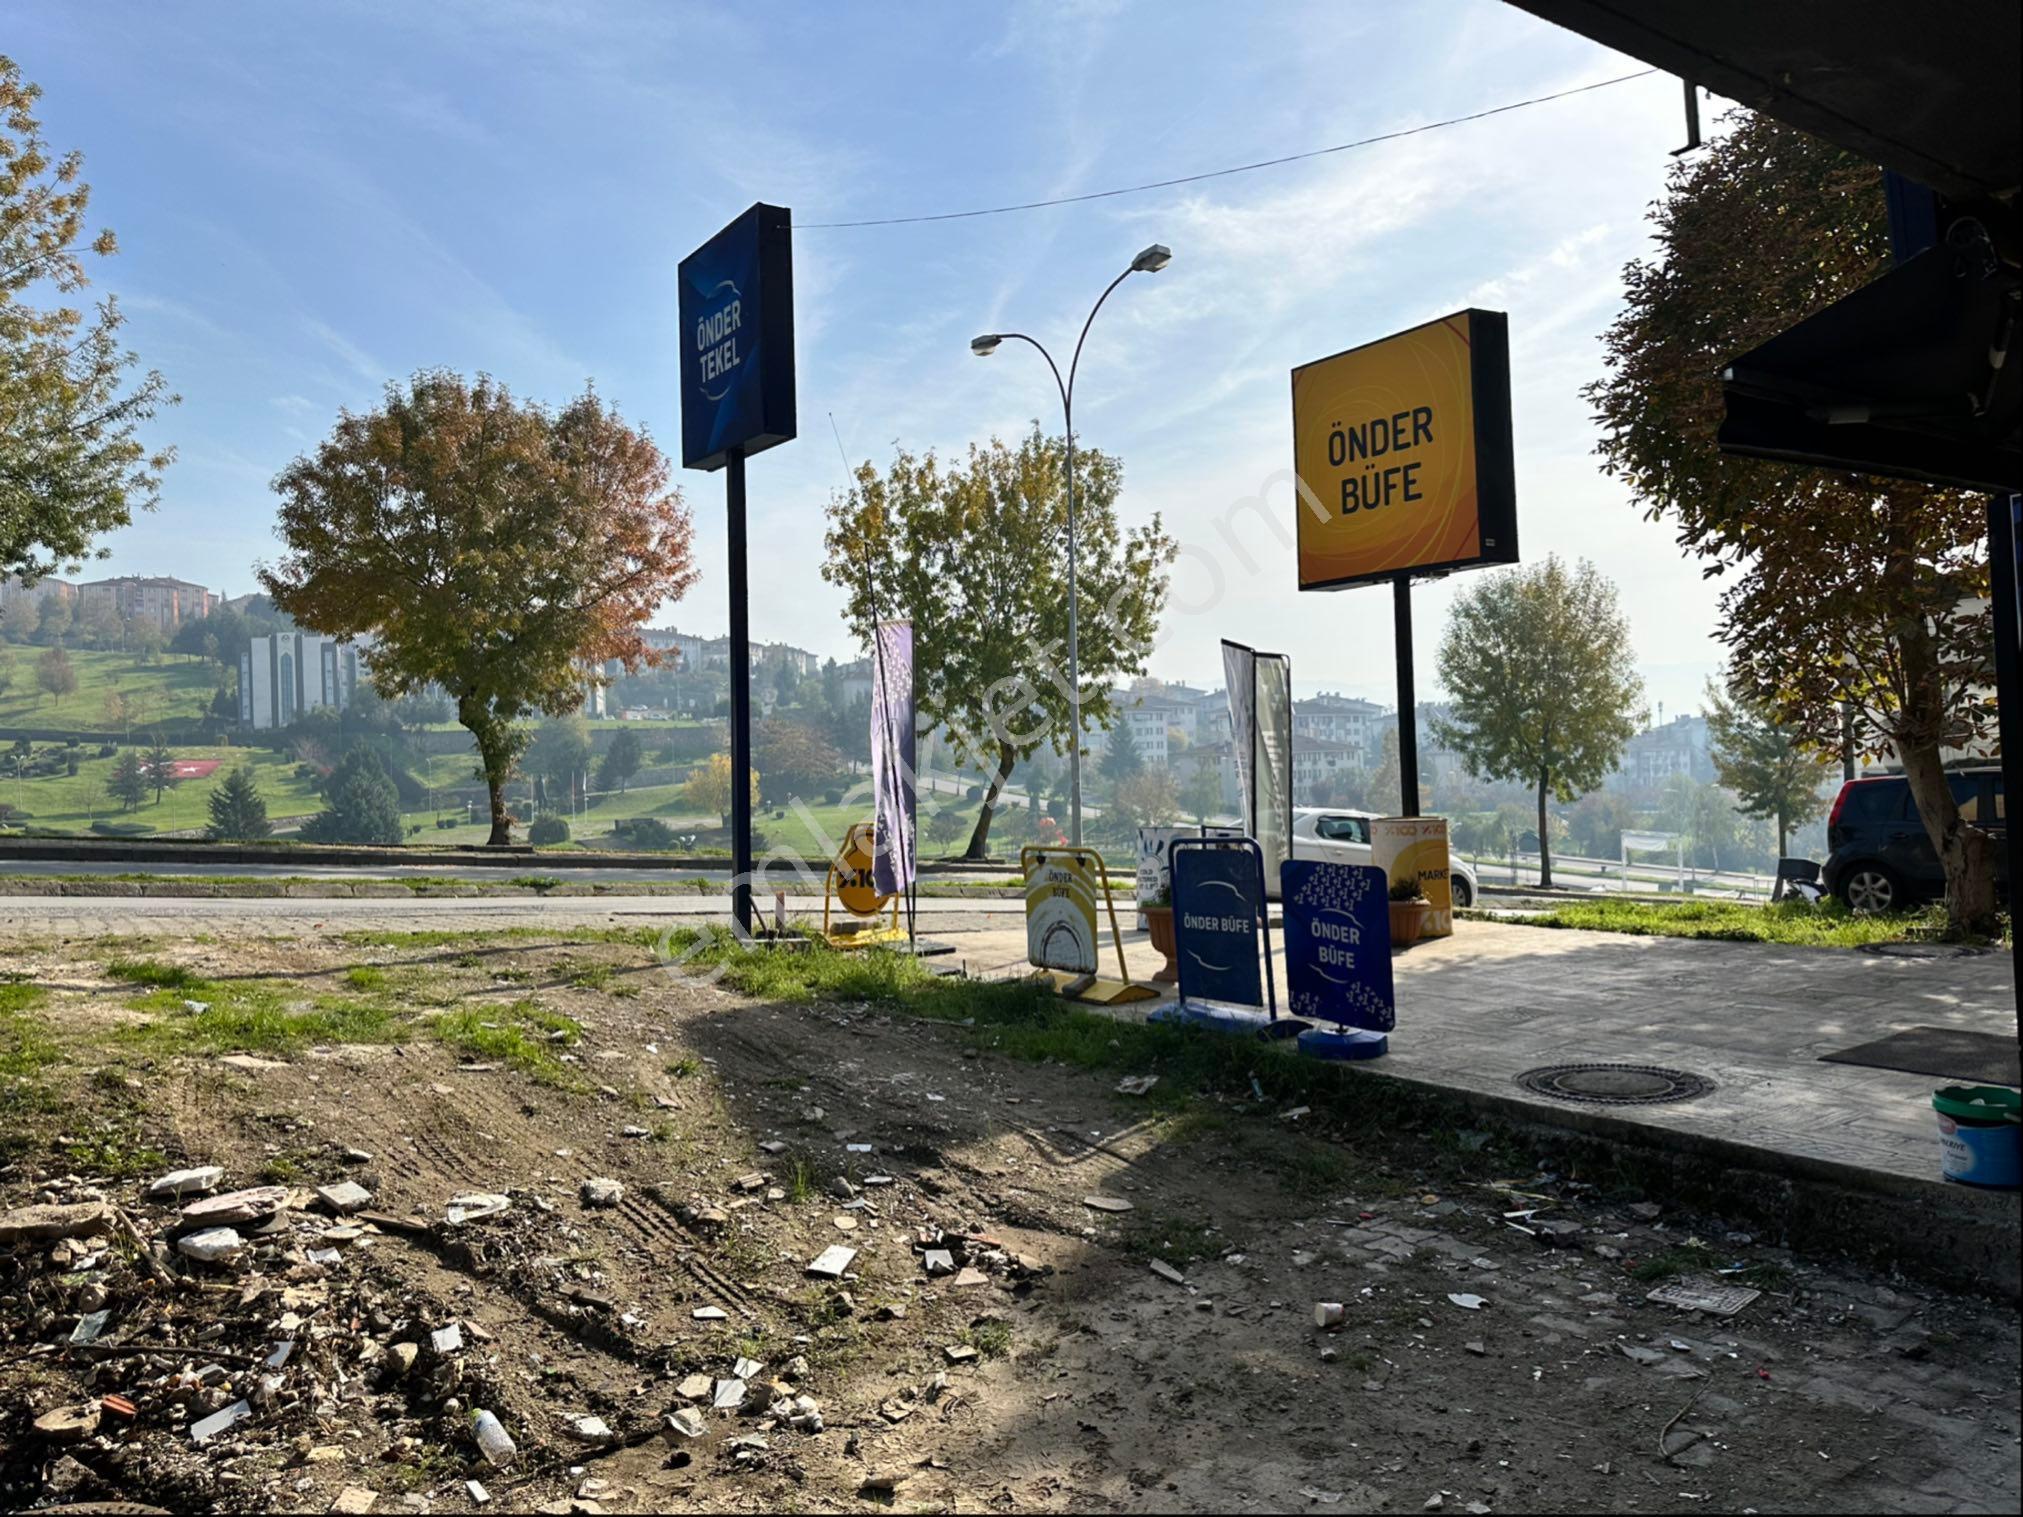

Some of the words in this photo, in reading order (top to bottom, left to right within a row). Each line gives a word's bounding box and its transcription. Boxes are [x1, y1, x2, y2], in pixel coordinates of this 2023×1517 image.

[697, 300, 741, 352] ÖNDER
[700, 336, 741, 384] TEKEL
[1328, 406, 1433, 467] ÖNDER
[1341, 462, 1422, 515] BÜFE
[1049, 869, 1073, 883] ÖNDER
[1184, 912, 1219, 931] ÖNDER
[1221, 916, 1250, 934] BÜFE
[1311, 917, 1360, 944] ÖNDER
[1318, 945, 1356, 970] BÜFE
